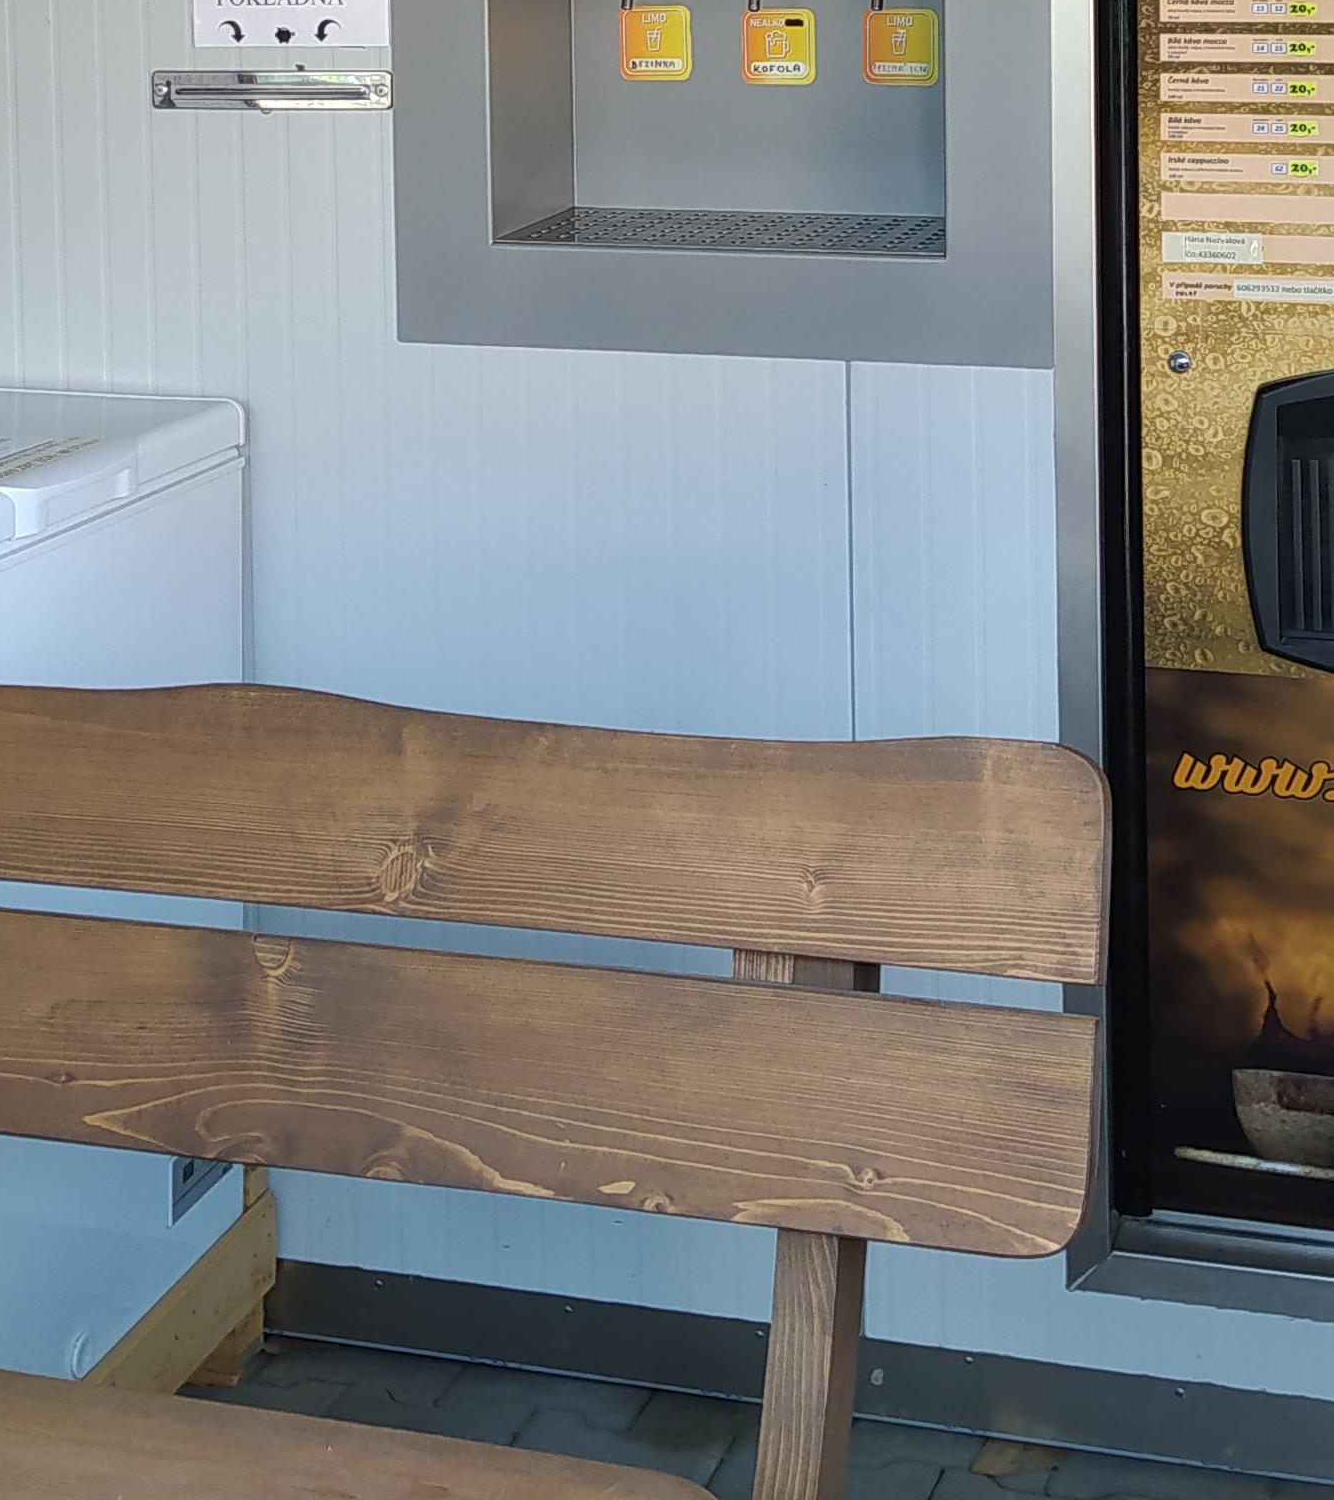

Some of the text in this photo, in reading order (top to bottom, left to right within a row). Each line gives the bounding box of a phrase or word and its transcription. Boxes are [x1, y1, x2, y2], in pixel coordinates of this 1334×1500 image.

[642, 13, 667, 24] LIMO
[887, 15, 914, 26] LIMO
[753, 64, 801, 73] KOFOLA
[1187, 157, 1229, 165] cappuccino
[1185, 235, 1204, 243] Hana
[1204, 283, 1232, 291] poruchy
[1281, 285, 1302, 293] nebo
